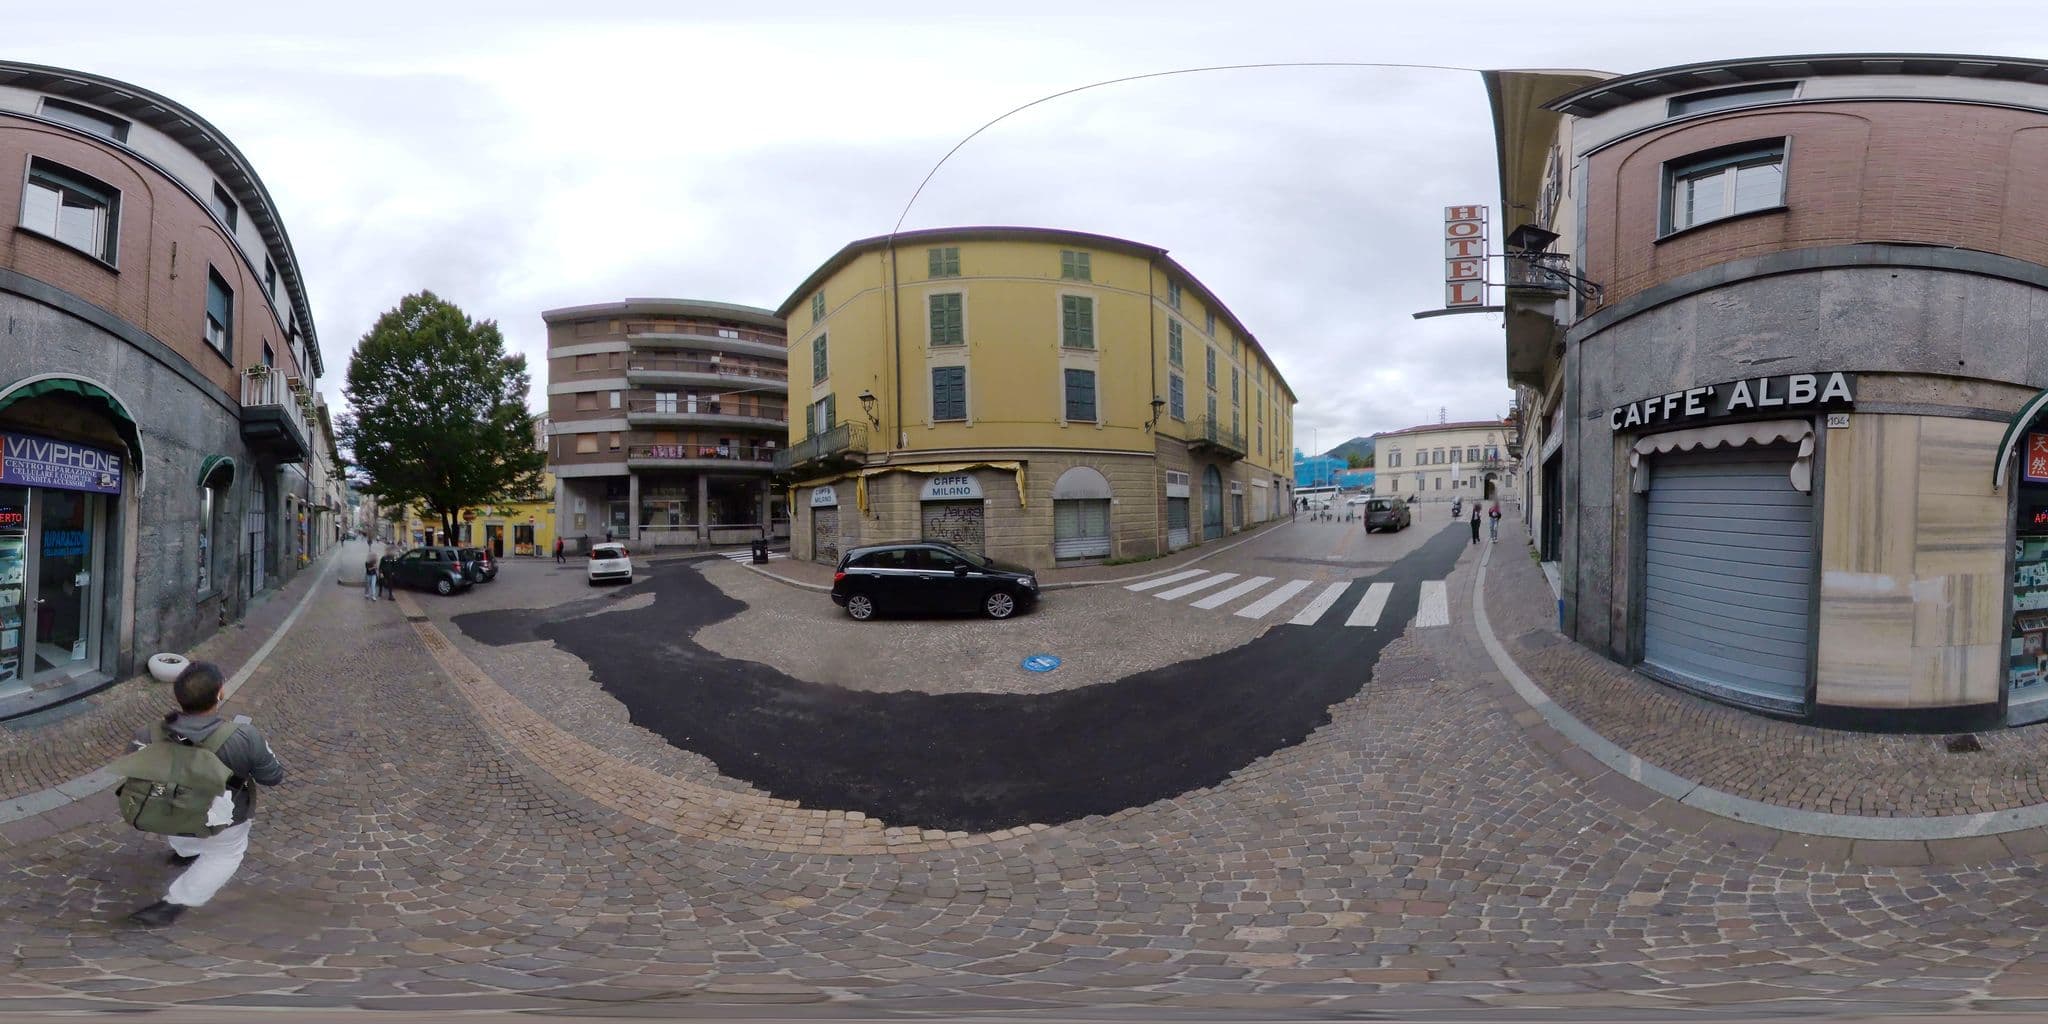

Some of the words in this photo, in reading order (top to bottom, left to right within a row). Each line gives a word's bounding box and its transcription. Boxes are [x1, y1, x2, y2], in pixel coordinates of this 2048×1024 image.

[1447, 206, 1479, 304] HOTEL
[1727, 372, 1853, 410] ALBA
[7, 436, 120, 474] VIVIPHONE
[5, 459, 44, 471] CENTRO
[45, 464, 97, 477] RIPARAZIONE
[12, 467, 53, 478] CELLULARE
[21, 474, 51, 484] VENDITA
[53, 478, 86, 488] ACCESSORI
[932, 486, 971, 496] MILANO
